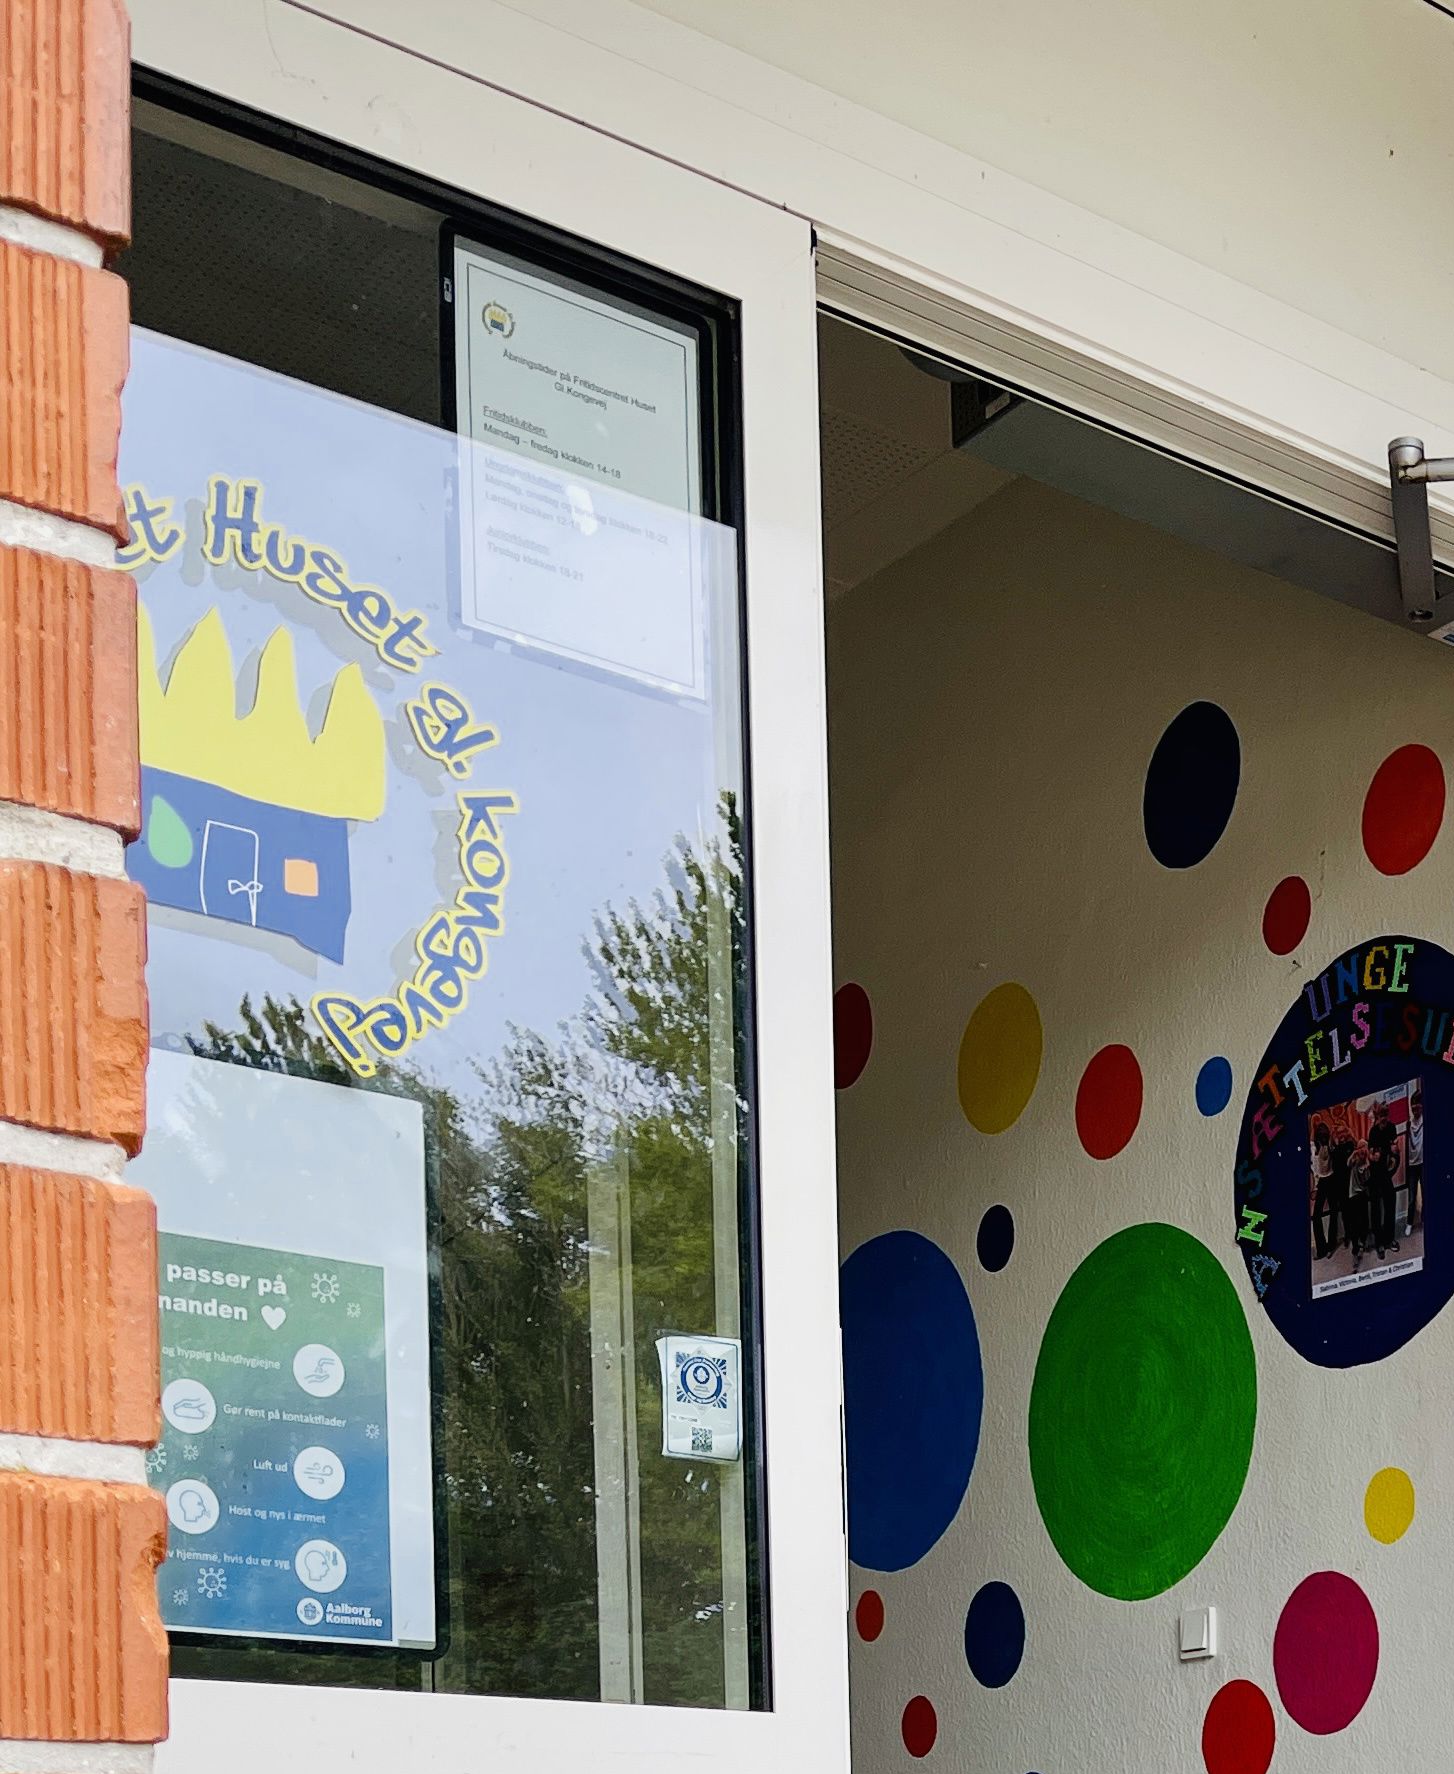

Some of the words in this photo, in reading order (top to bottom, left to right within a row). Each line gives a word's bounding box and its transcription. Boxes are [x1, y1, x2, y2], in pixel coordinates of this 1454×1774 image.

[211, 480, 430, 667] Huset
[1304, 943, 1415, 1022] UNGE
[166, 1263, 251, 1289] passer
[257, 1273, 287, 1296] på
[158, 1294, 248, 1321] nanden
[177, 1346, 212, 1362] hyppig
[213, 1351, 281, 1370] håndhygiejne
[223, 1403, 243, 1415] Gør
[244, 1408, 265, 1419] rent
[267, 1409, 281, 1421] på
[282, 1411, 347, 1428] kontaktflader
[253, 1459, 272, 1470] Luft
[275, 1462, 288, 1472] ud
[228, 1505, 252, 1516] Host
[254, 1509, 267, 1520] og
[269, 1510, 285, 1521] nys
[293, 1513, 326, 1524] ærmet
[223, 1552, 244, 1565] hvis
[246, 1554, 258, 1566] du
[260, 1557, 272, 1567] er
[273, 1560, 291, 1571] syg
[325, 1602, 372, 1619] Aalborg
[325, 1615, 383, 1628] Kommune
